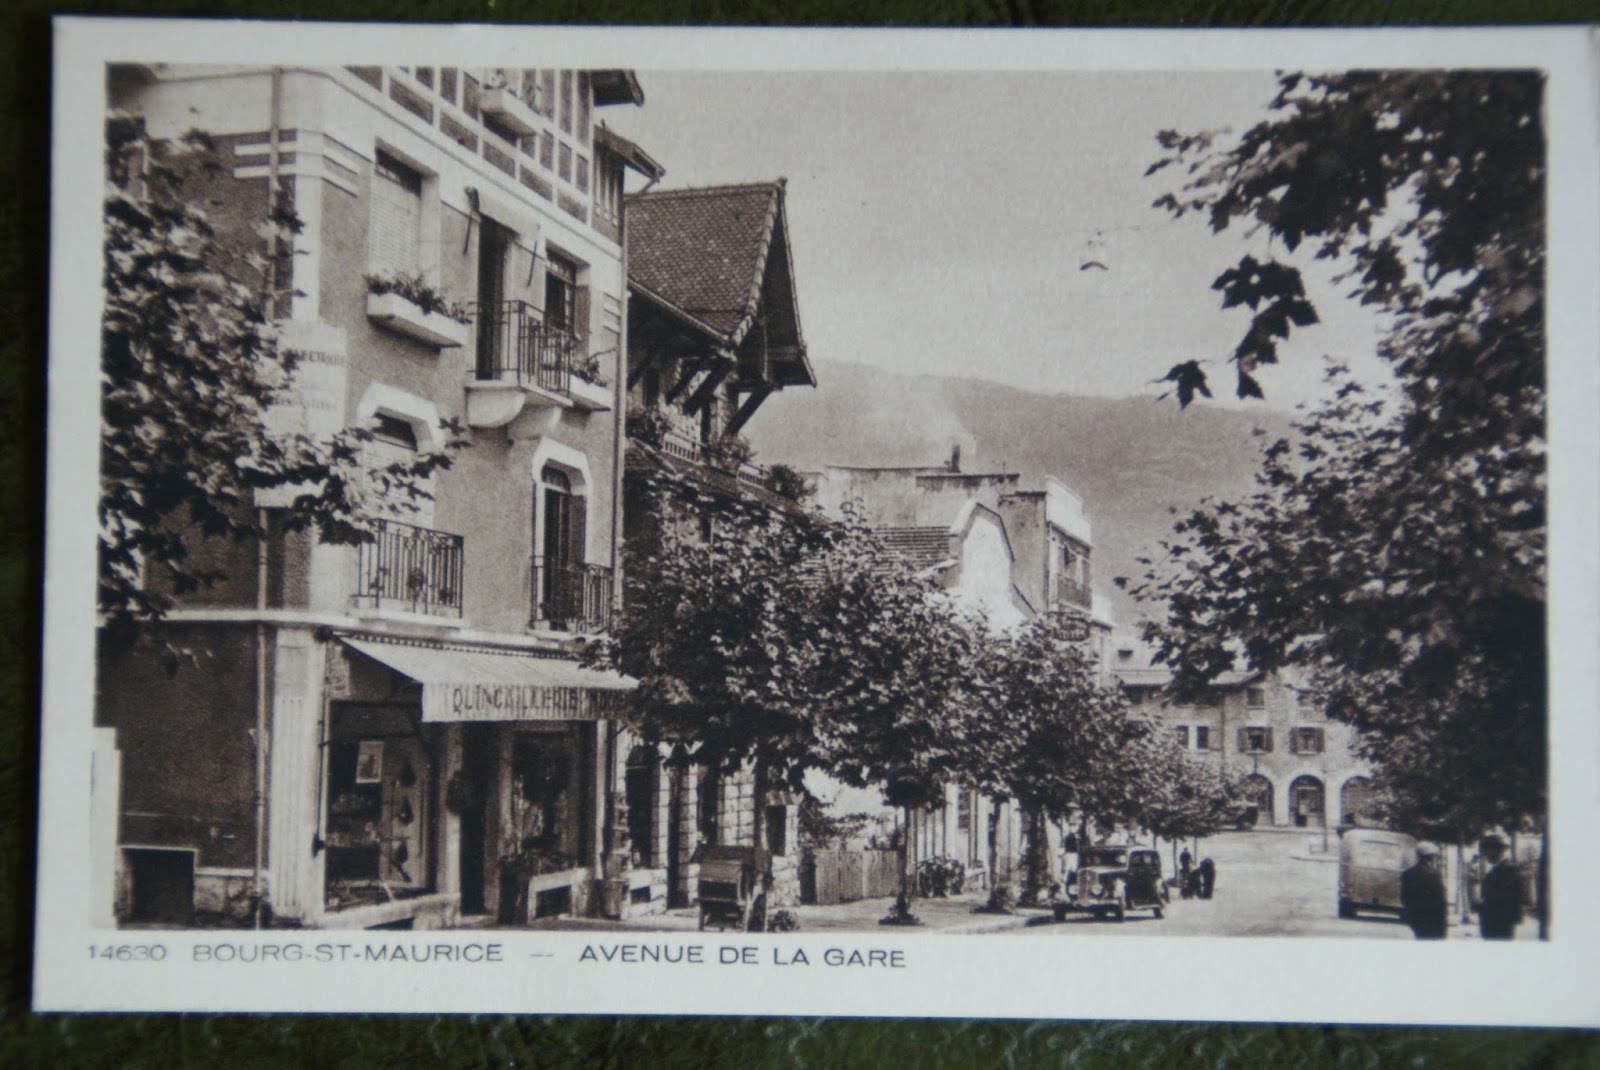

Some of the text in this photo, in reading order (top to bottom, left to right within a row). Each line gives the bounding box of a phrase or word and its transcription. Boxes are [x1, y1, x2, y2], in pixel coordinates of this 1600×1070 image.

[452, 685, 578, 714] QUINCAILLERIE
[88, 943, 168, 961] 14630
[192, 943, 504, 962] BOURG-ST-MAURICE
[578, 944, 705, 964] AVENUE
[718, 946, 760, 965] DE
[772, 947, 811, 966] LA
[823, 948, 907, 968] GARE
